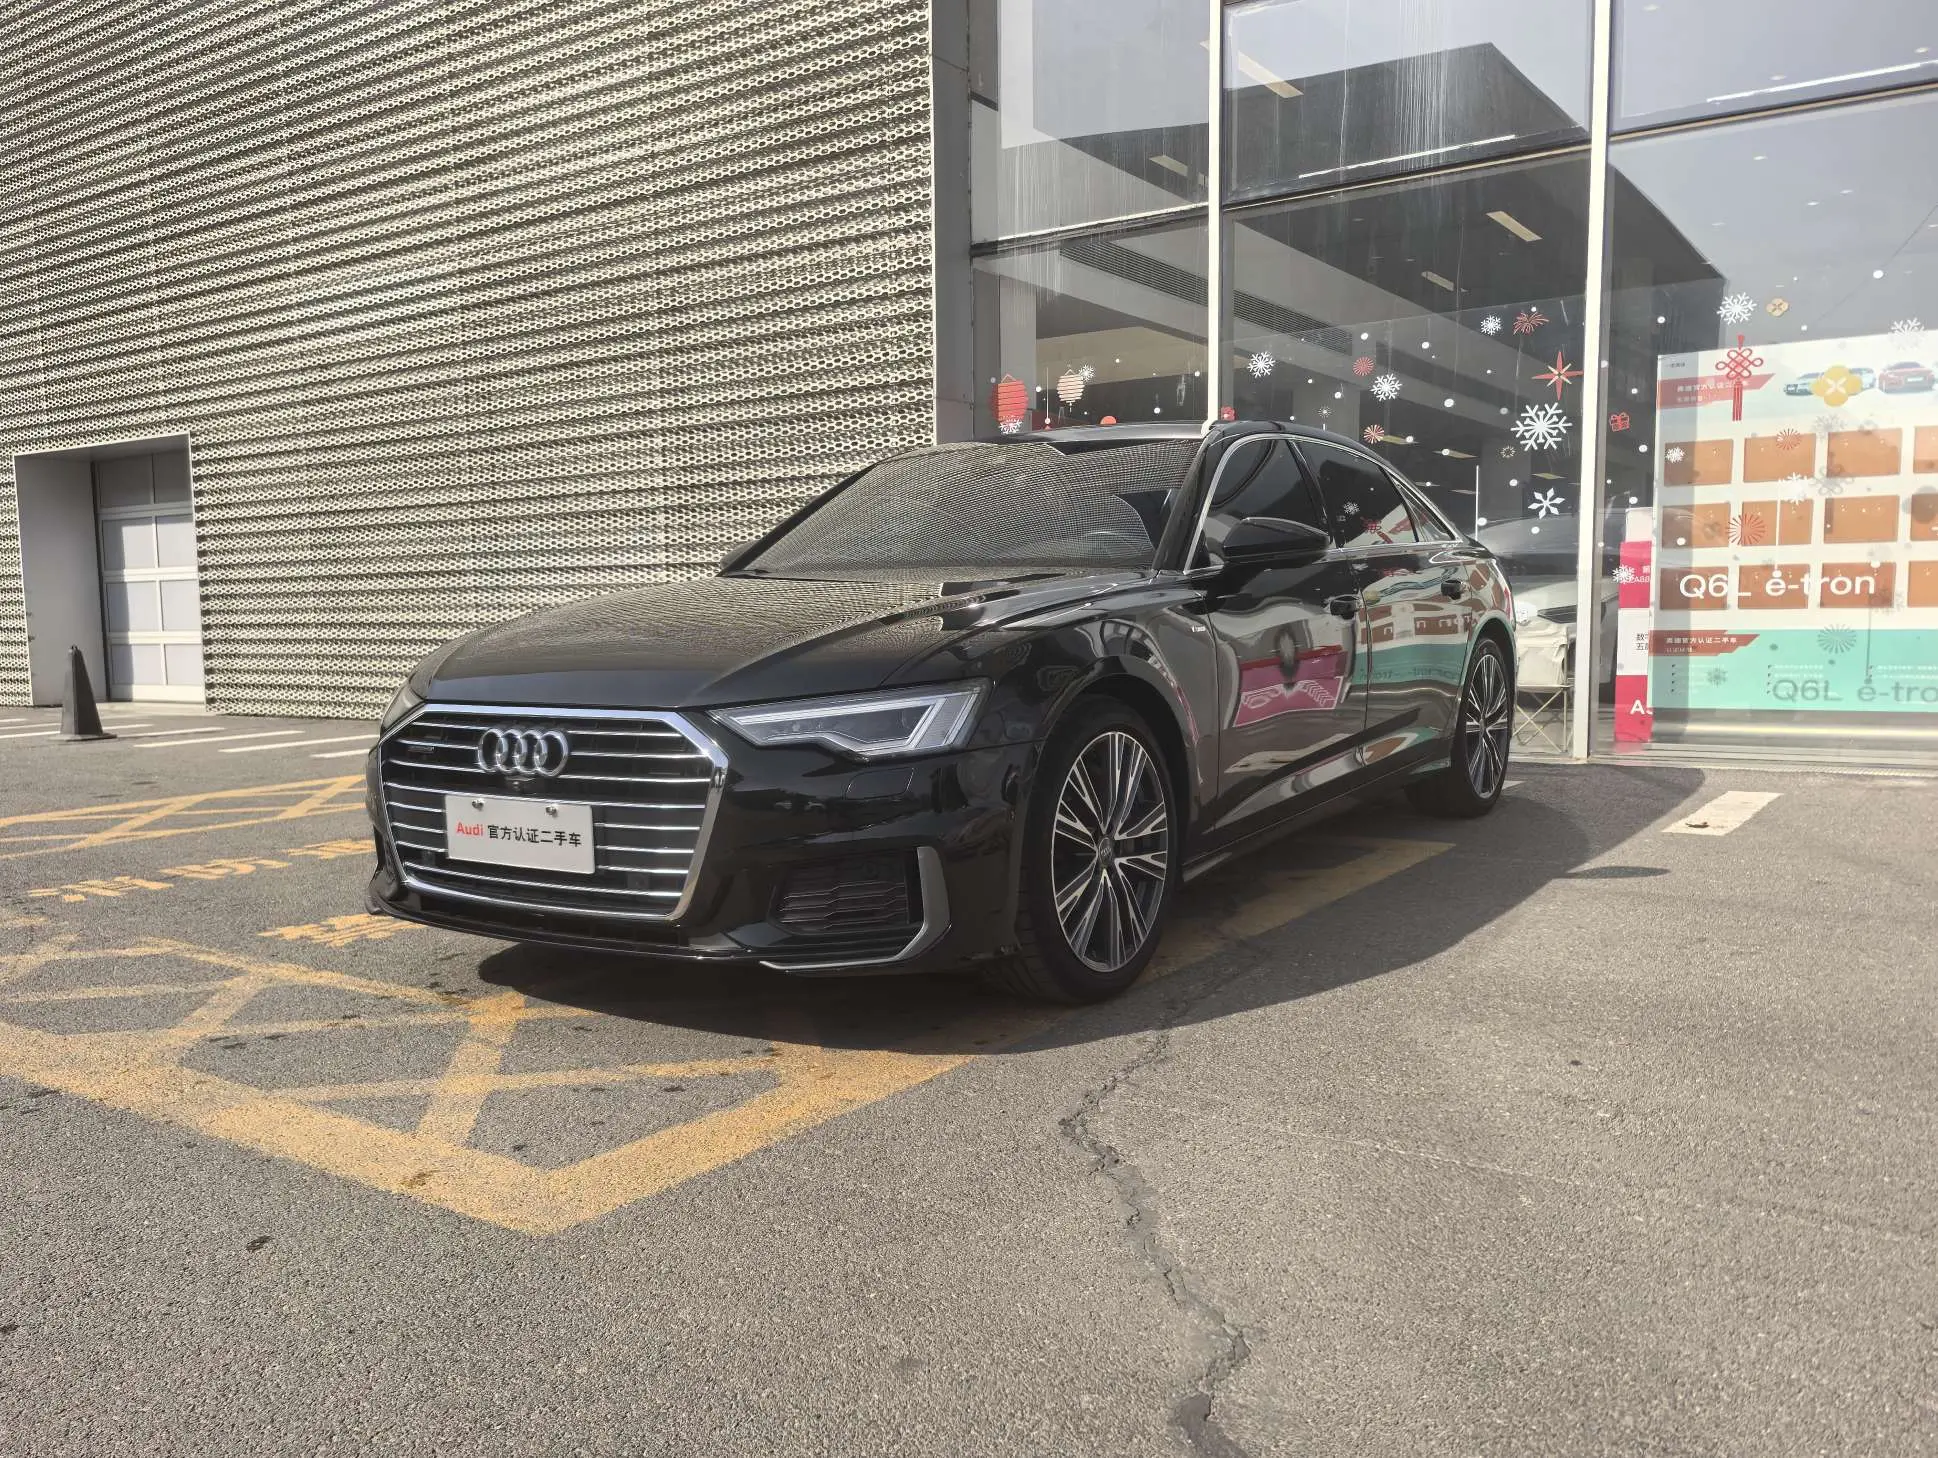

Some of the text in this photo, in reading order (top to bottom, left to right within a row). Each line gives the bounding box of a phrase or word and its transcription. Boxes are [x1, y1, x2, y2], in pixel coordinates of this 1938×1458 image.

[1765, 572, 1876, 596] e-tron
[457, 822, 581, 847] Audi 官方认证二手车
